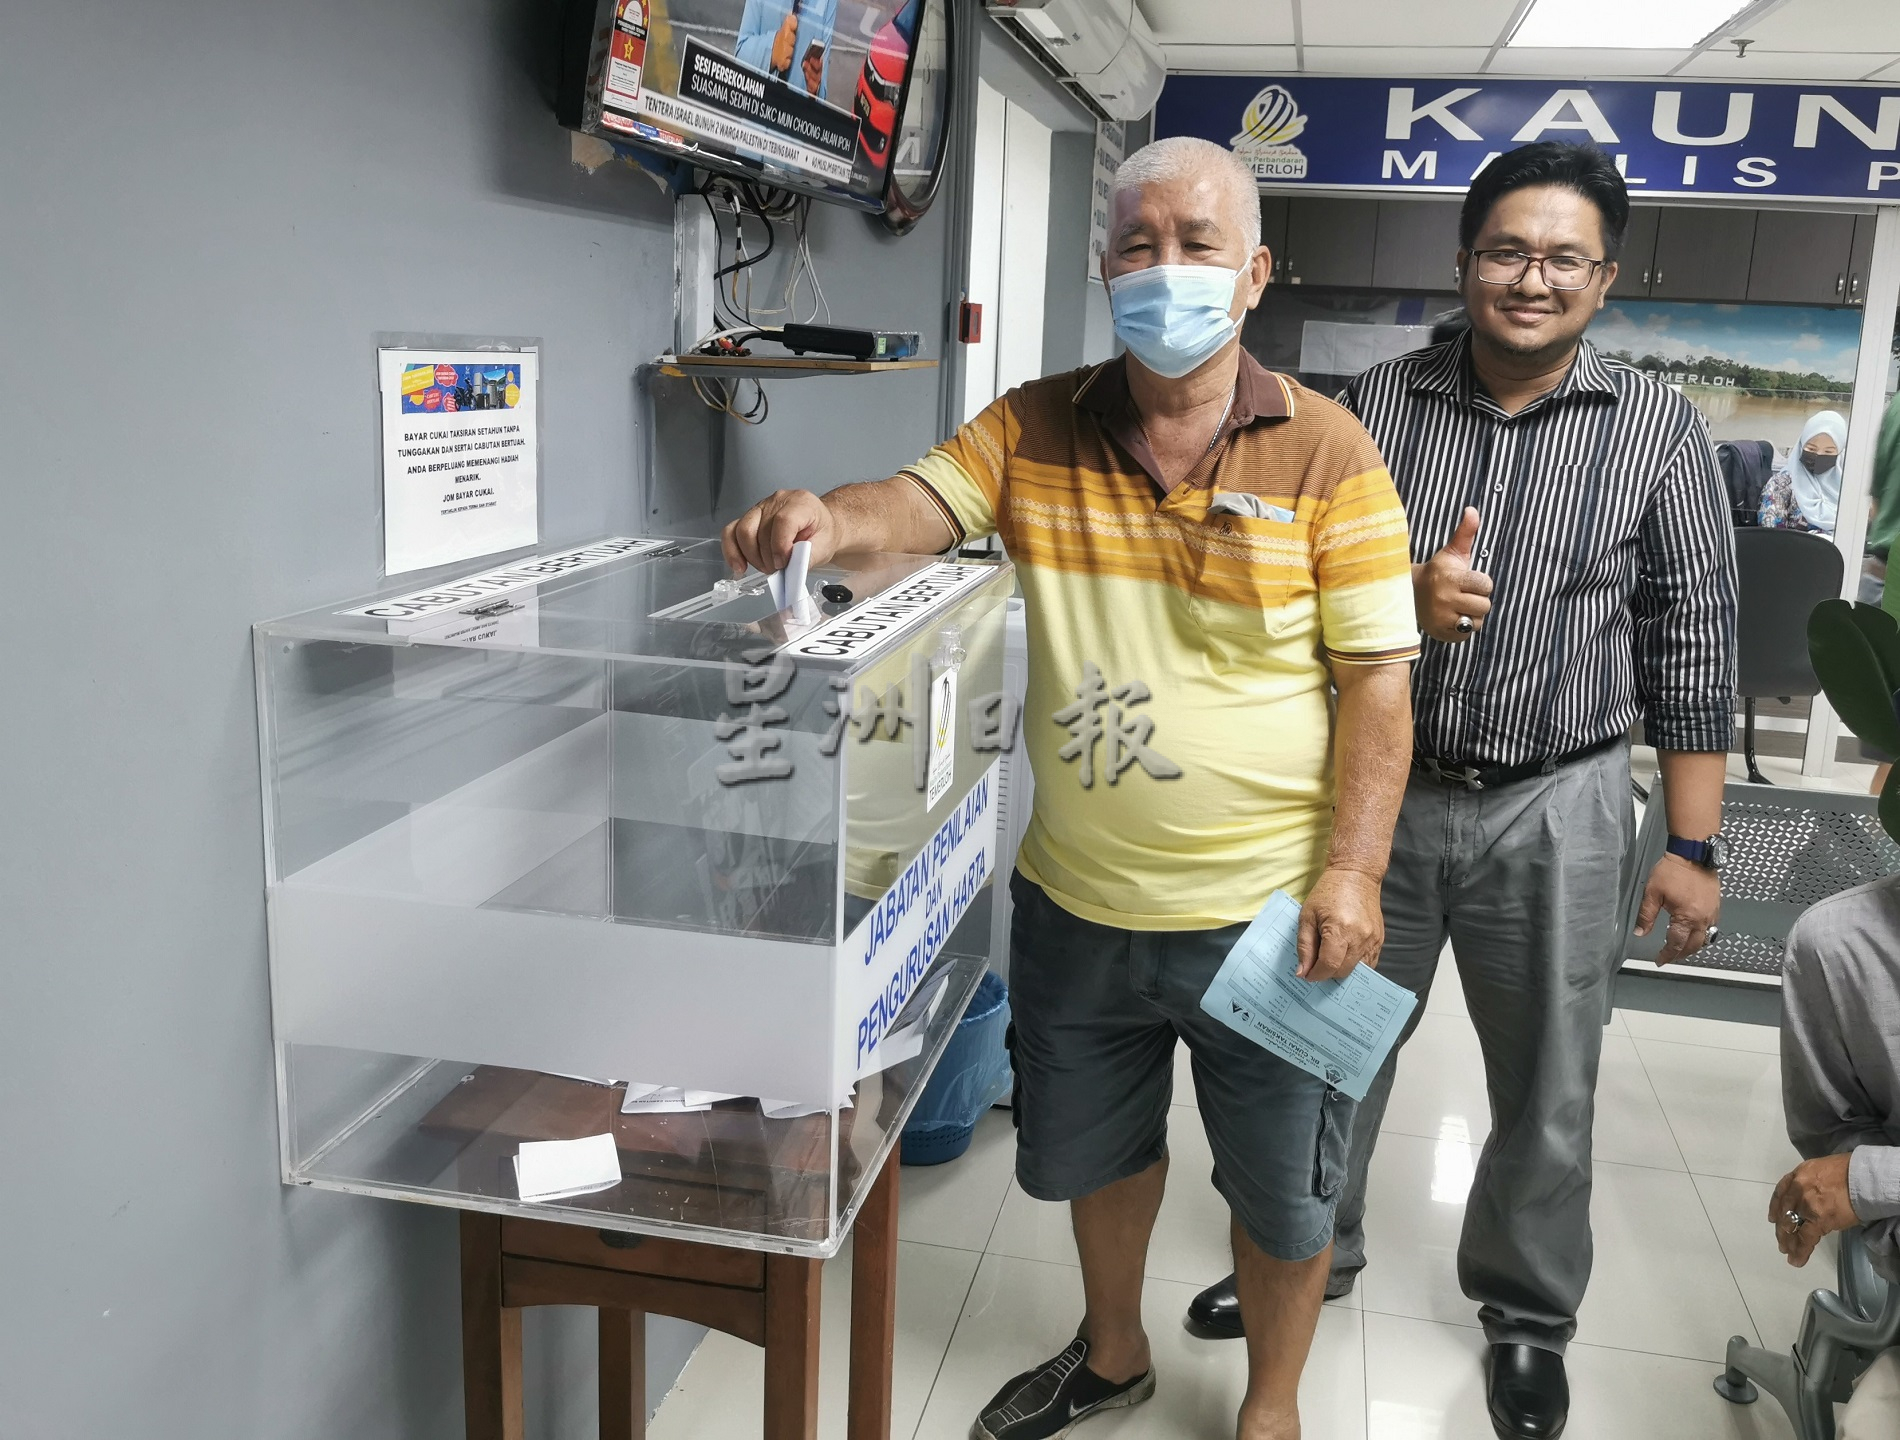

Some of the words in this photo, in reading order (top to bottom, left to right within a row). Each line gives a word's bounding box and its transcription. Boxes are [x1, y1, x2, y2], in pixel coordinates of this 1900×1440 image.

[694, 54, 711, 76] SESI
[711, 61, 765, 99] PERSEKOLAHAN
[645, 96, 673, 116] TENTERA
[673, 105, 694, 126] ISRAEL
[715, 121, 720, 134] 2
[719, 123, 740, 143] WARGA
[740, 130, 763, 149] PALESTIN
[768, 140, 786, 156] TEBING
[785, 146, 800, 160] BARAT
[691, 74, 728, 103] SUASANA
[729, 90, 751, 112] SEDIH
[751, 98, 760, 116] DI
[759, 102, 778, 122] SJKC
[777, 110, 793, 130] MUN
[793, 117, 821, 140] CHOONG
[820, 129, 838, 147] JALAN
[837, 136, 851, 151] IPOH
[1386, 87, 1900, 151] KAUN
[1253, 156, 1304, 164] Perbandaran
[1640, 369, 1735, 388] EMERLOH
[397, 446, 440, 458] TUNGGAKAN
[441, 445, 454, 454] DAN
[454, 442, 473, 453] SERTAI
[474, 440, 501, 450] CABUTAN
[501, 438, 526, 448] BERTUAH.
[404, 432, 428, 442] BAYAR
[429, 430, 448, 440] CUKAI
[450, 428, 477, 438] TAKSIRAN
[477, 426, 503, 436] SETAHUN
[503, 425, 520, 433] TANPA
[407, 465, 427, 475] ANDA
[428, 460, 465, 473] BERPELUANG
[466, 456, 500, 468] MEMENANGI
[501, 454, 519, 464] HADIAH
[454, 473, 481, 484] MENARIK.
[442, 493, 455, 503] JOM
[455, 490, 474, 501] BAYAR
[474, 487, 494, 498] CUKAI.
[364, 571, 540, 617] CABUTAN
[520, 539, 655, 574] BERTUAH
[800, 601, 920, 656] CABUTAN
[890, 565, 980, 603] BERTUAH
[864, 844, 930, 966] JABATAN
[932, 773, 989, 877] PENILAIAN
[925, 873, 943, 919] DAN
[857, 895, 950, 1071] PENGURUSAN
[952, 846, 986, 926] HARTA
[1257, 1021, 1288, 1044] TAKSIRAN
[1288, 1042, 1309, 1058] CUKAI
